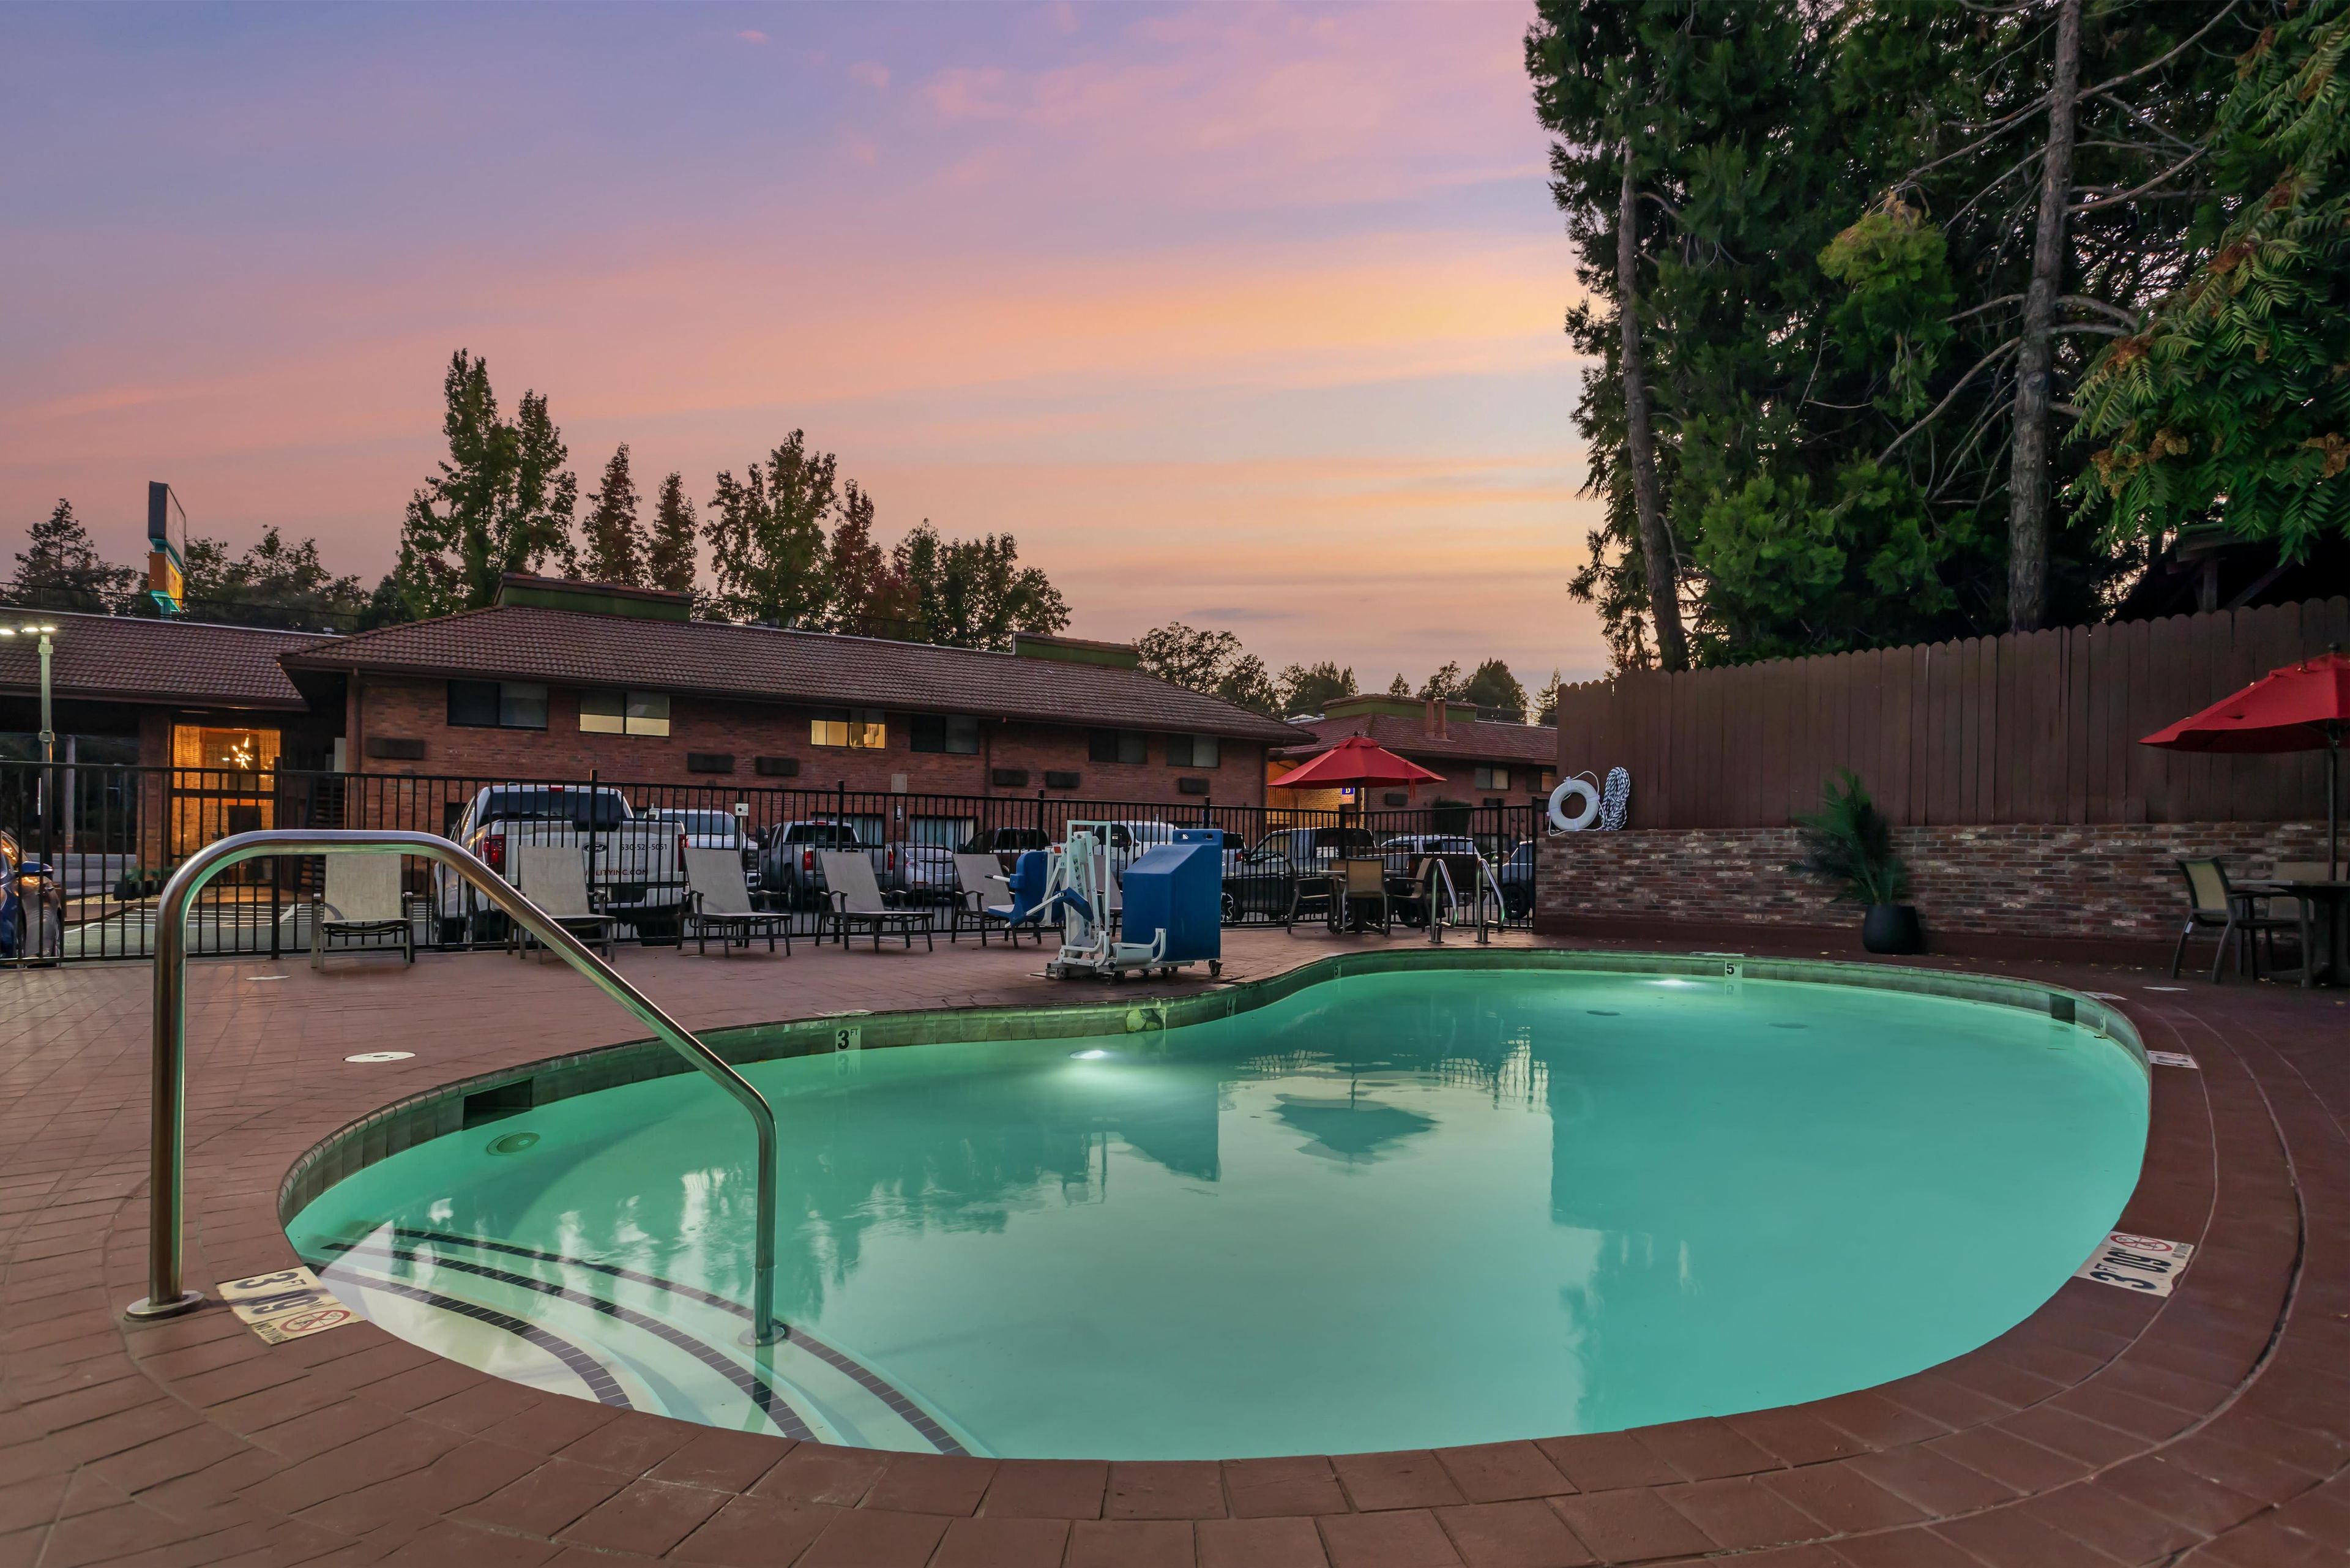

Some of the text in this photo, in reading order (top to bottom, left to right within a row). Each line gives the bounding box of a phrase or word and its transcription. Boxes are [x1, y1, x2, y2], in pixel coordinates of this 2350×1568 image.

[1335, 964, 1338, 976] 5
[1726, 963, 1734, 974] 5
[838, 1029, 849, 1049] 3
[234, 1272, 307, 1290] 3 FT
[2090, 1263, 2157, 1290] 3 FT
